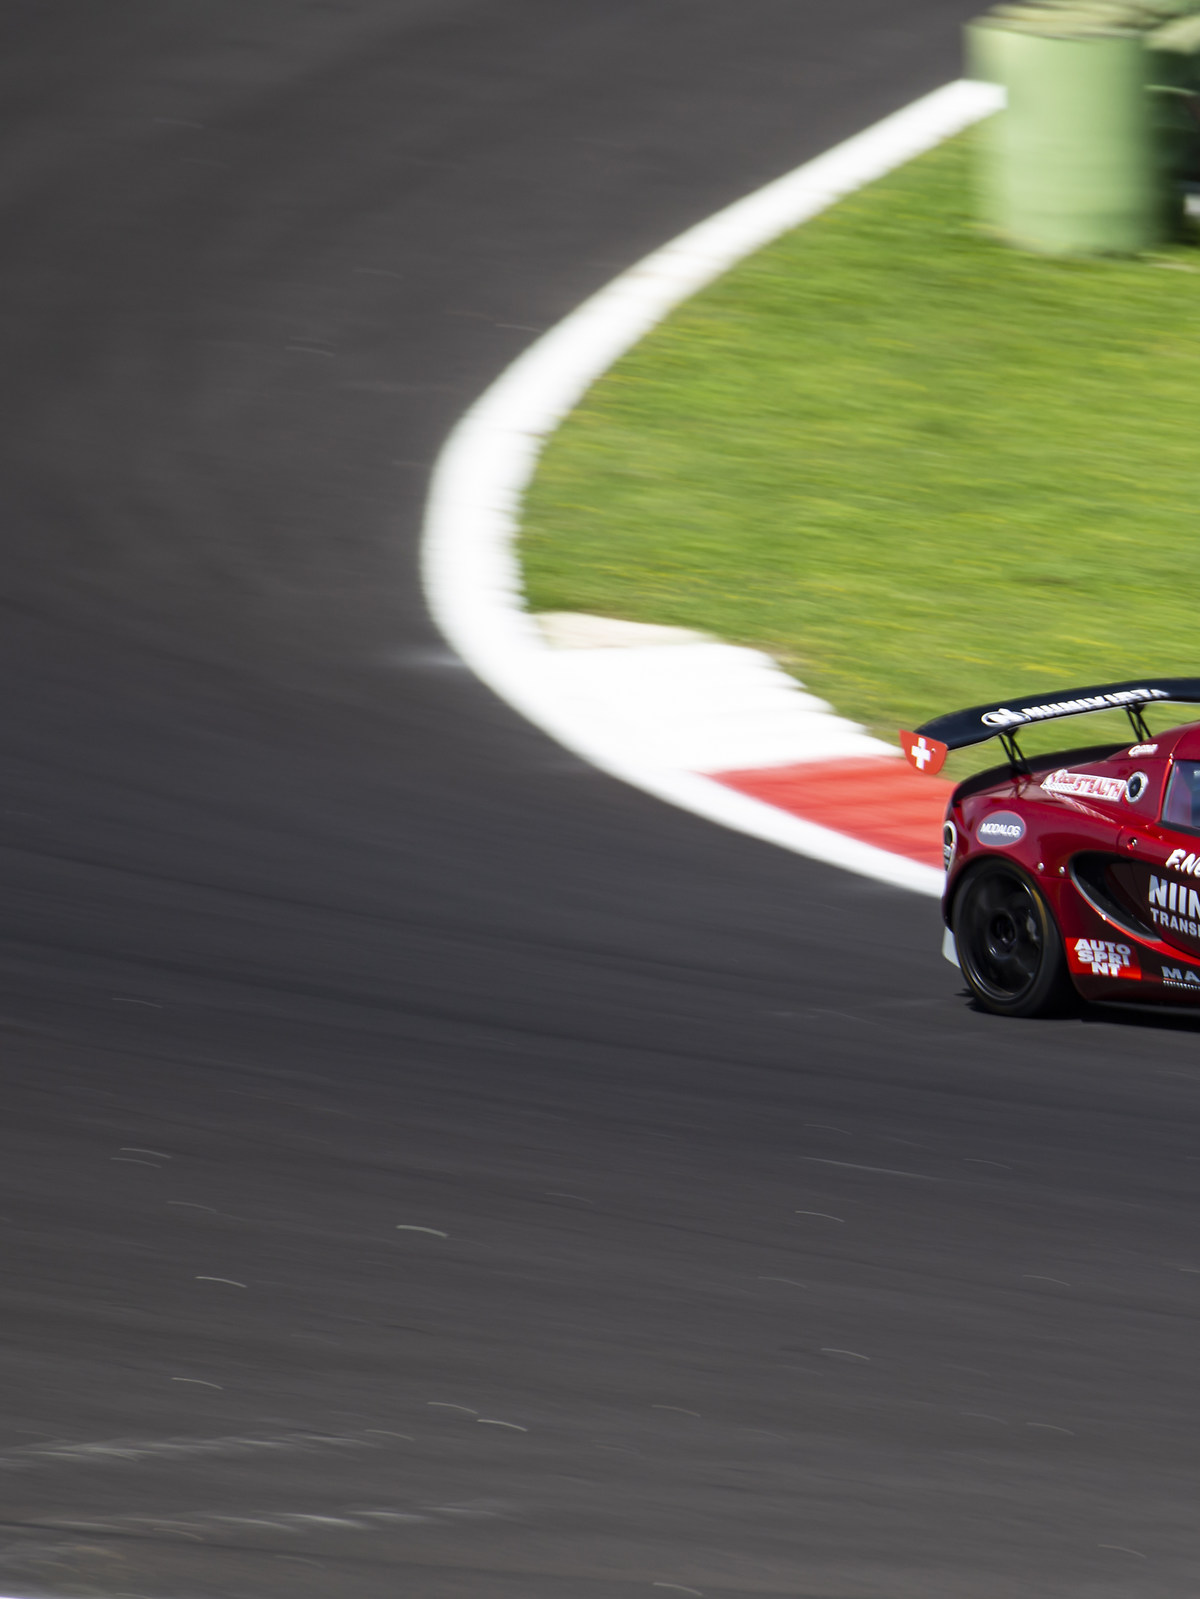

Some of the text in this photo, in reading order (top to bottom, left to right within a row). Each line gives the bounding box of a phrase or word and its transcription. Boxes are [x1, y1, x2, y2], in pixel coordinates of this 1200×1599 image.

[1074, 777, 1123, 798] STEALTH
[980, 823, 1021, 838] MODALOG
[1074, 938, 1131, 955] AUTO
[1077, 950, 1130, 967] SPRI
[1091, 962, 1121, 977] NT
